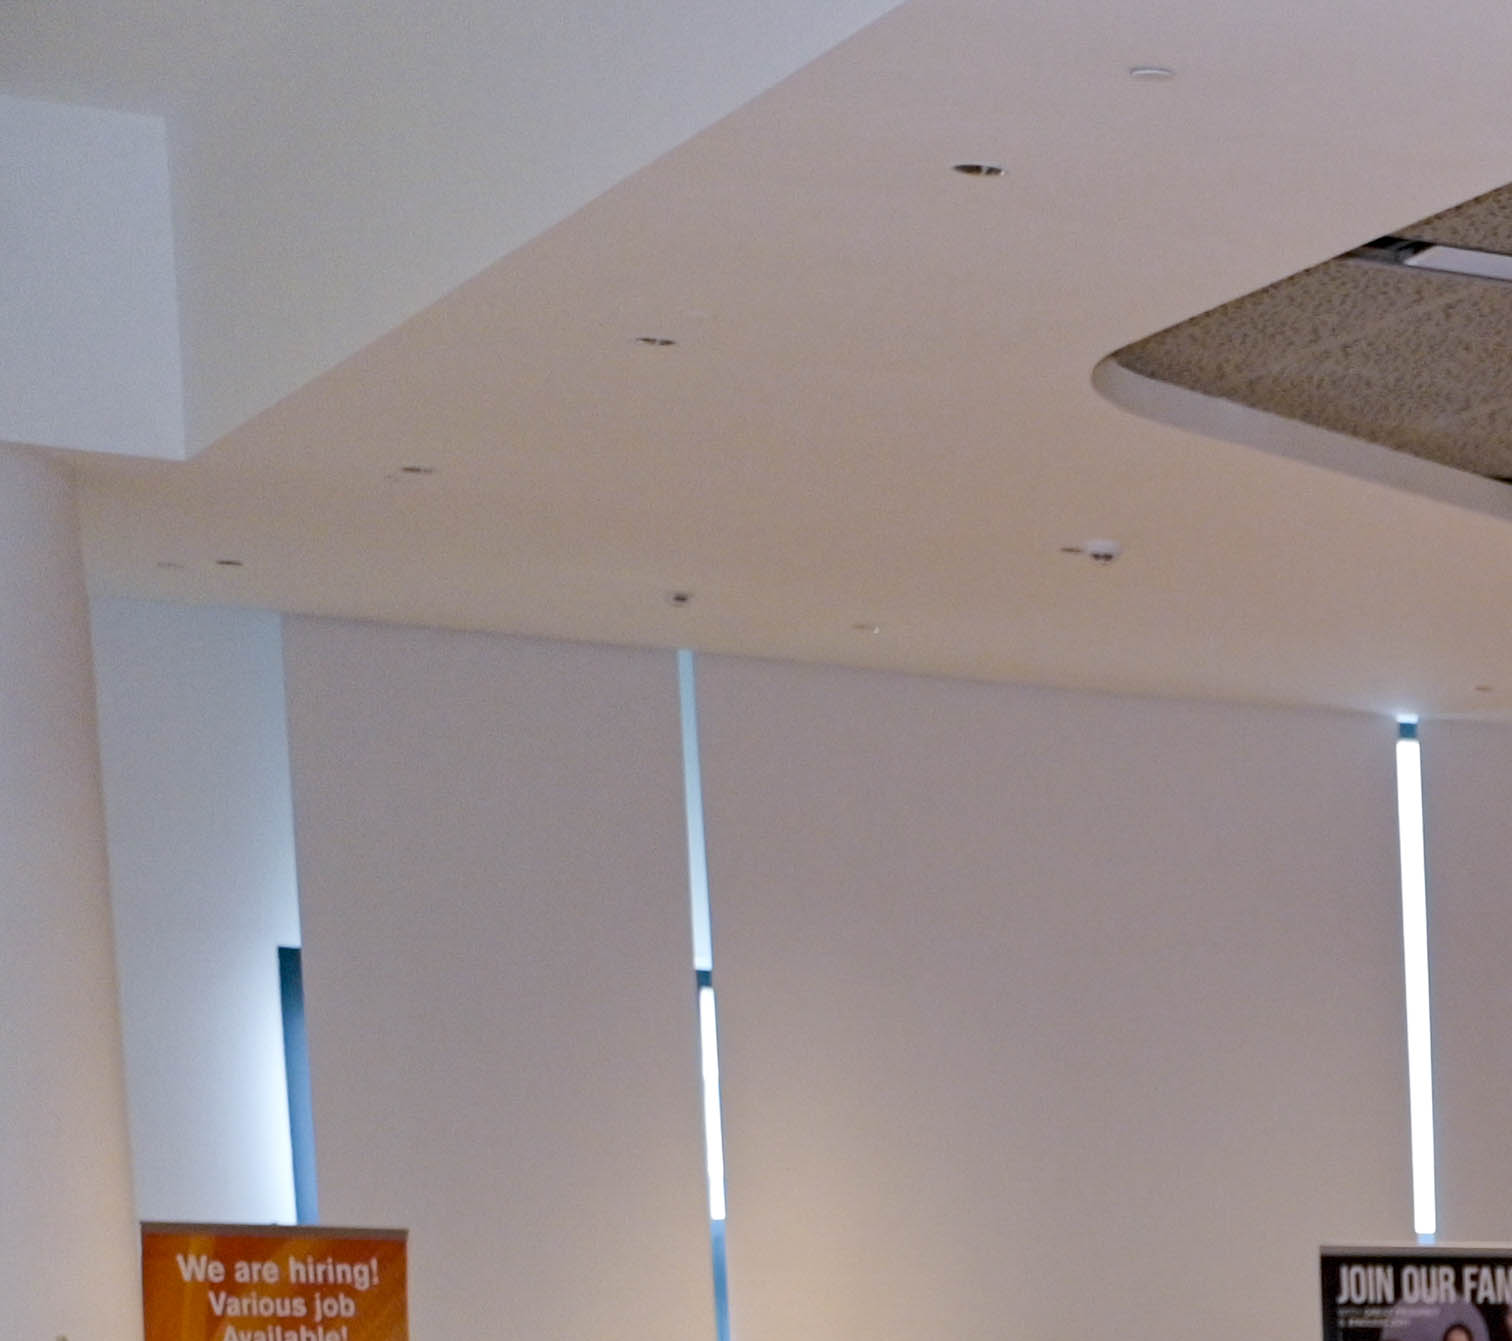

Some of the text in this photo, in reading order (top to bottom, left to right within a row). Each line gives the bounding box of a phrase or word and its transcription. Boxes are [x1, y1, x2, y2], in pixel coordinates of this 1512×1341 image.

[176, 1252, 379, 1291] We are hiring!
[1337, 1264, 1394, 1305] JOIN
[1402, 1265, 1456, 1304] OUR
[208, 1291, 356, 1322] Various job
